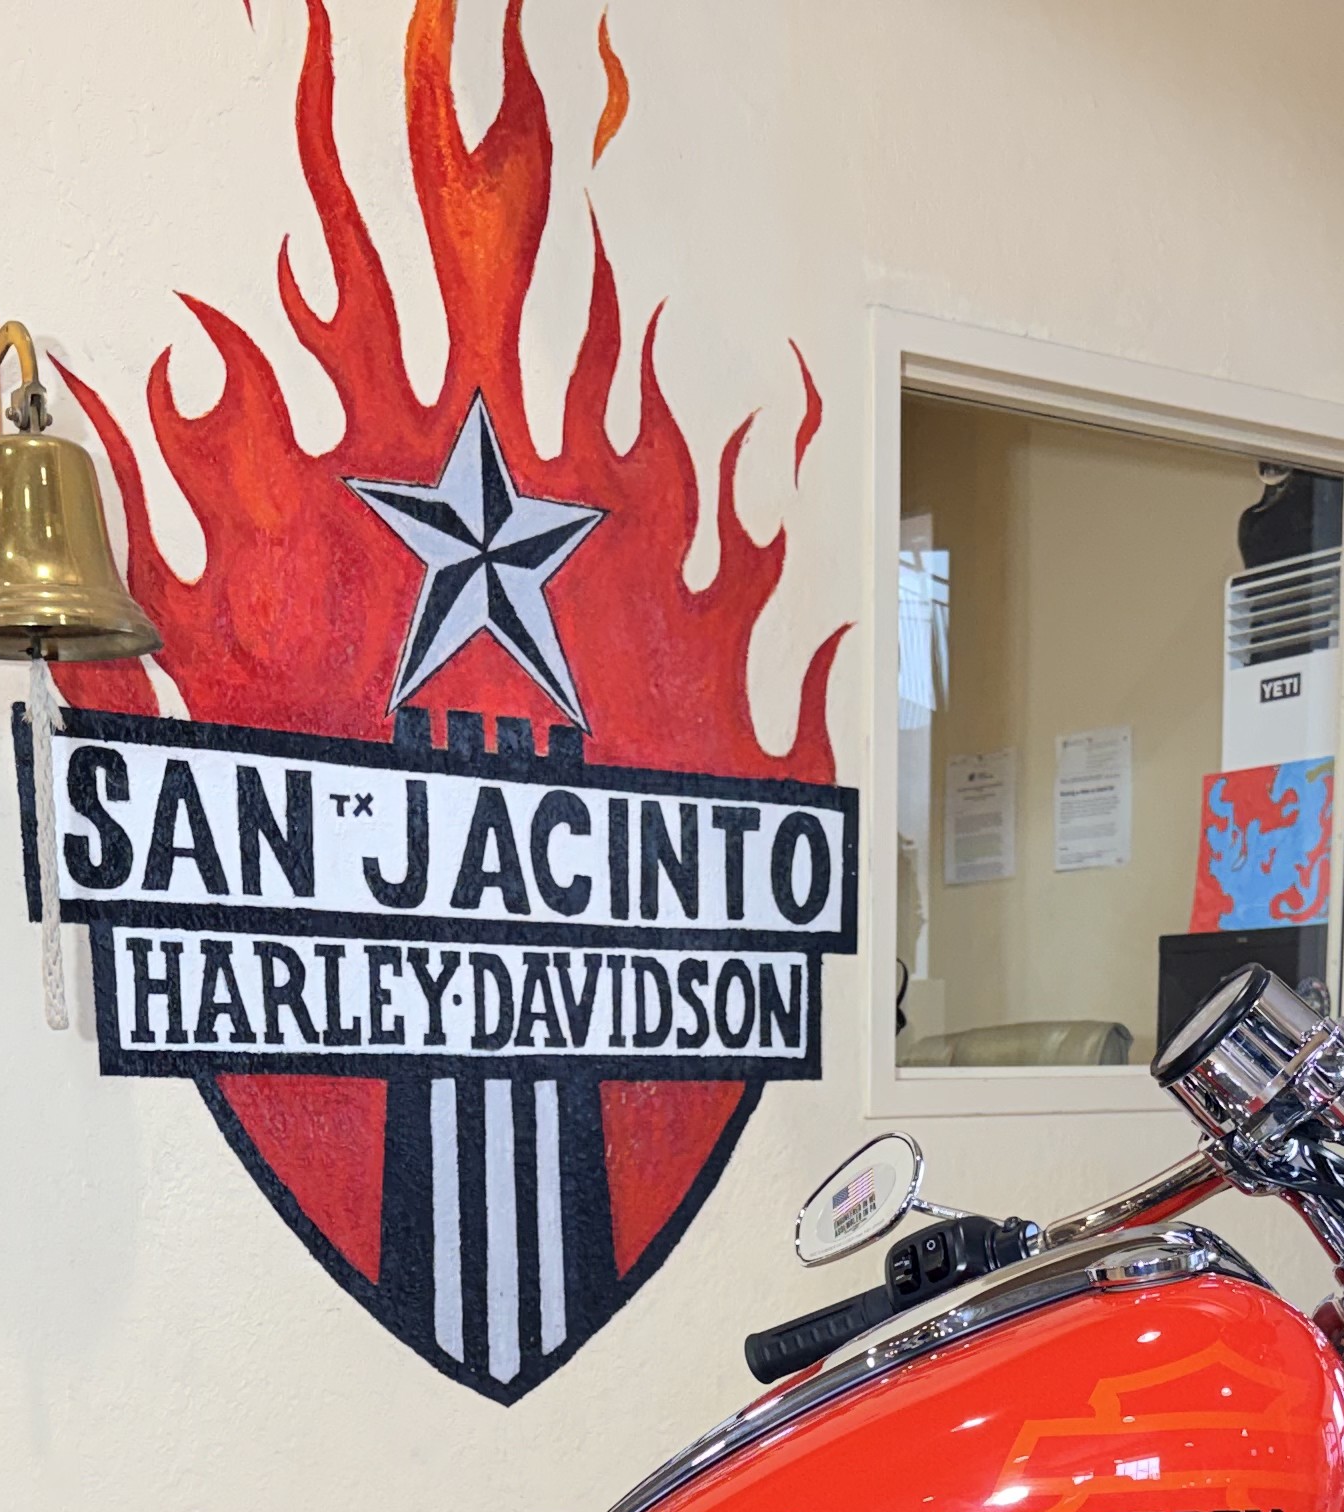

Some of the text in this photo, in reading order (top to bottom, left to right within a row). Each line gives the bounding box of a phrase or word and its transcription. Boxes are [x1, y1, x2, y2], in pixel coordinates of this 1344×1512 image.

[1259, 673, 1300, 702] YETI
[63, 743, 316, 898] SAN
[329, 792, 374, 818] TX
[362, 778, 831, 926] JACINTO
